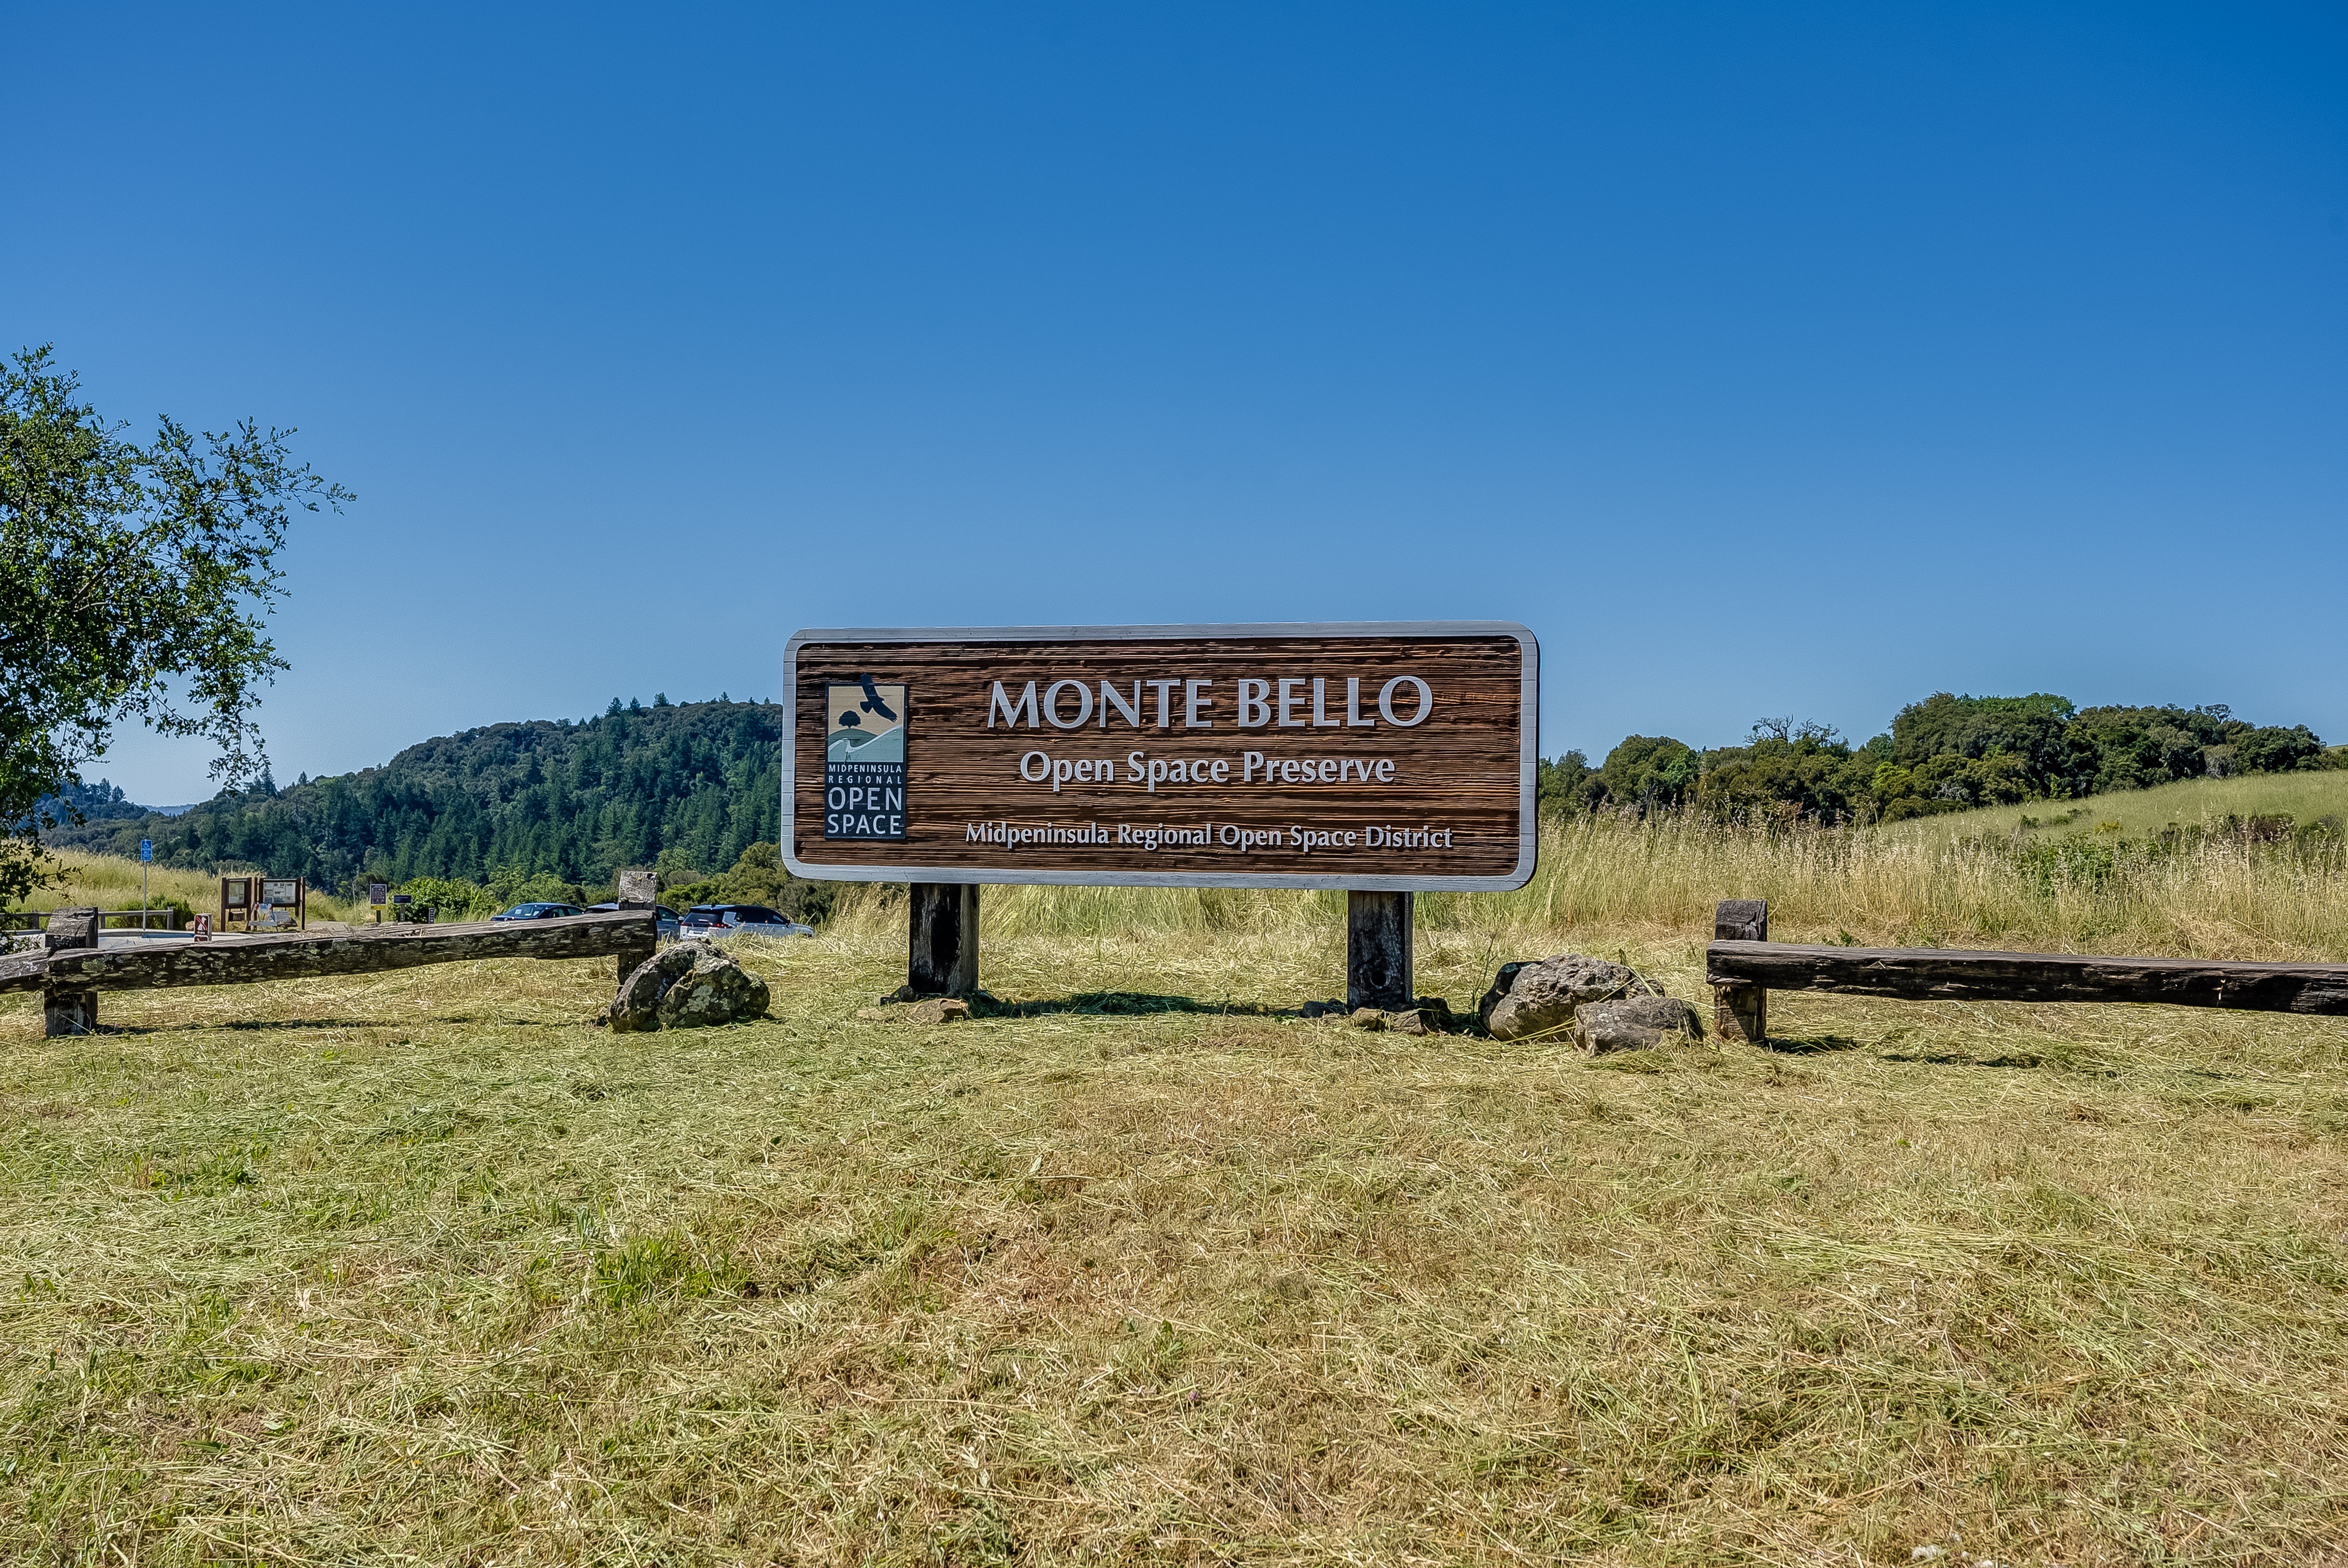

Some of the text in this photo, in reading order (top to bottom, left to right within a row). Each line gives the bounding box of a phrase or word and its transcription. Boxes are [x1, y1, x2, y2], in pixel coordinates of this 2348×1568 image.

[987, 676, 1433, 728] MONTE BELLO
[828, 764, 902, 773] MIDPENINSULA
[1020, 751, 1395, 792] Open Space Preserve
[828, 787, 902, 810] OPEN
[827, 814, 901, 834] SPACE
[965, 822, 1452, 852] Midpeninsula Regional Open Space District
